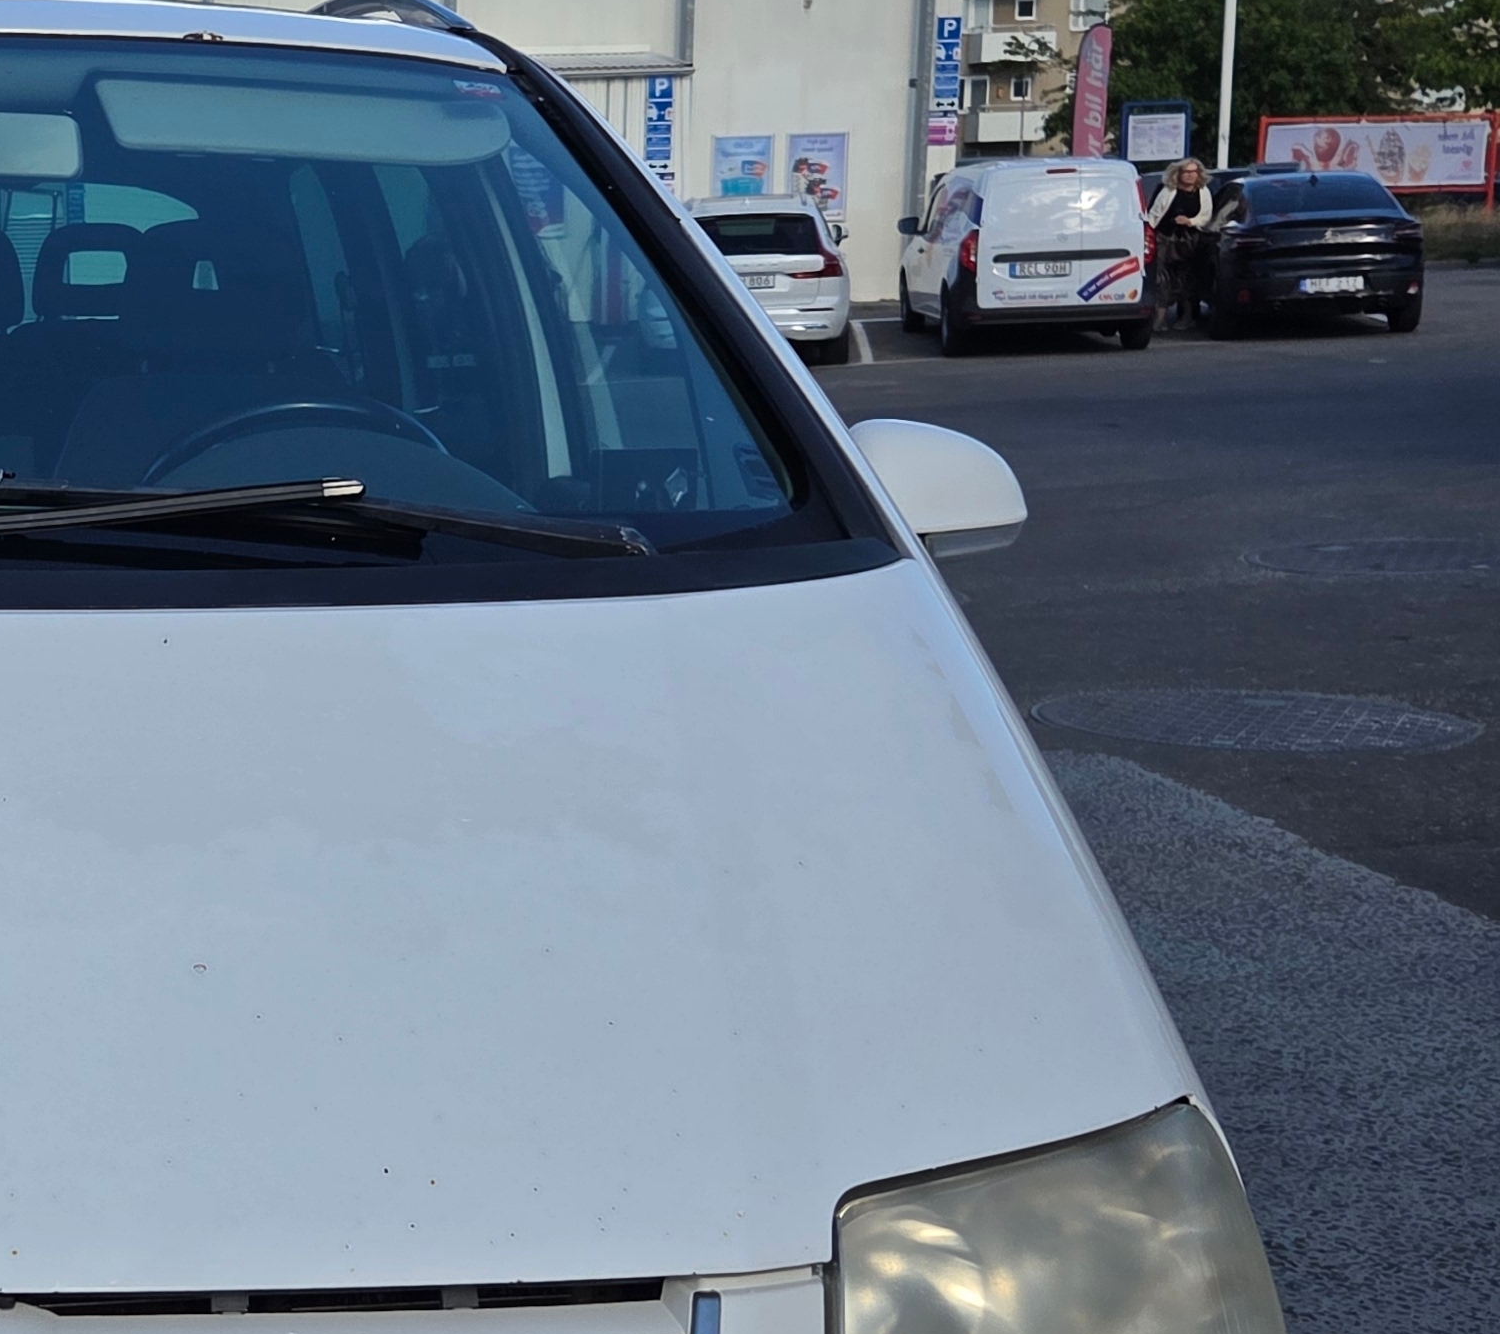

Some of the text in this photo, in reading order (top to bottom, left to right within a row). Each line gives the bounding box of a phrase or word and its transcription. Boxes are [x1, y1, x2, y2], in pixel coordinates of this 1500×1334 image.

[943, 19, 958, 38] P
[655, 78, 669, 98] P
[1084, 93, 1101, 128] bil
